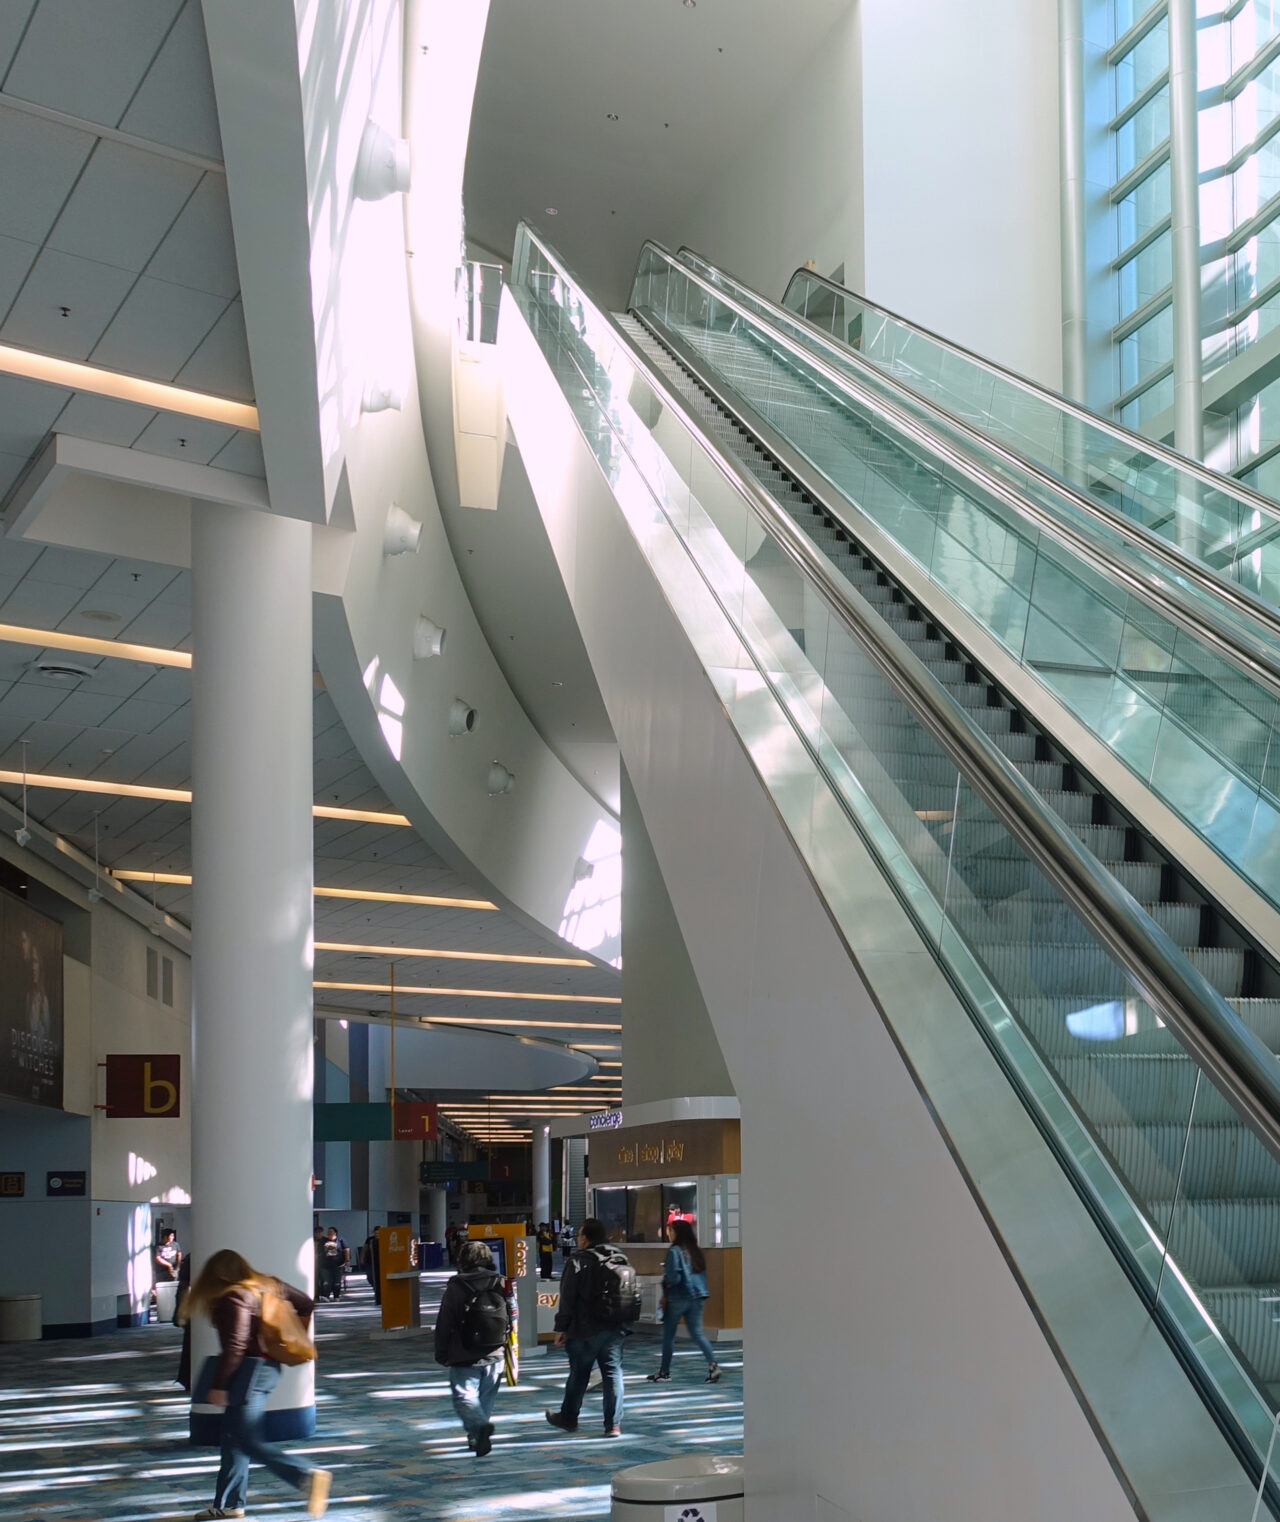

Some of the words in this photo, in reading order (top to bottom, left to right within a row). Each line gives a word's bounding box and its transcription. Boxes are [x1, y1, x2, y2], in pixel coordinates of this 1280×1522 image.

[18, 1053, 55, 1076] WITCHES
[143, 1062, 177, 1114] b
[421, 1115, 429, 1133] 1
[590, 1109, 623, 1129] concierge
[618, 1146, 634, 1163] dine
[642, 1143, 659, 1163] shop
[667, 1139, 684, 1163] play
[514, 1240, 529, 1278] shop
[535, 1290, 560, 1309] lay
